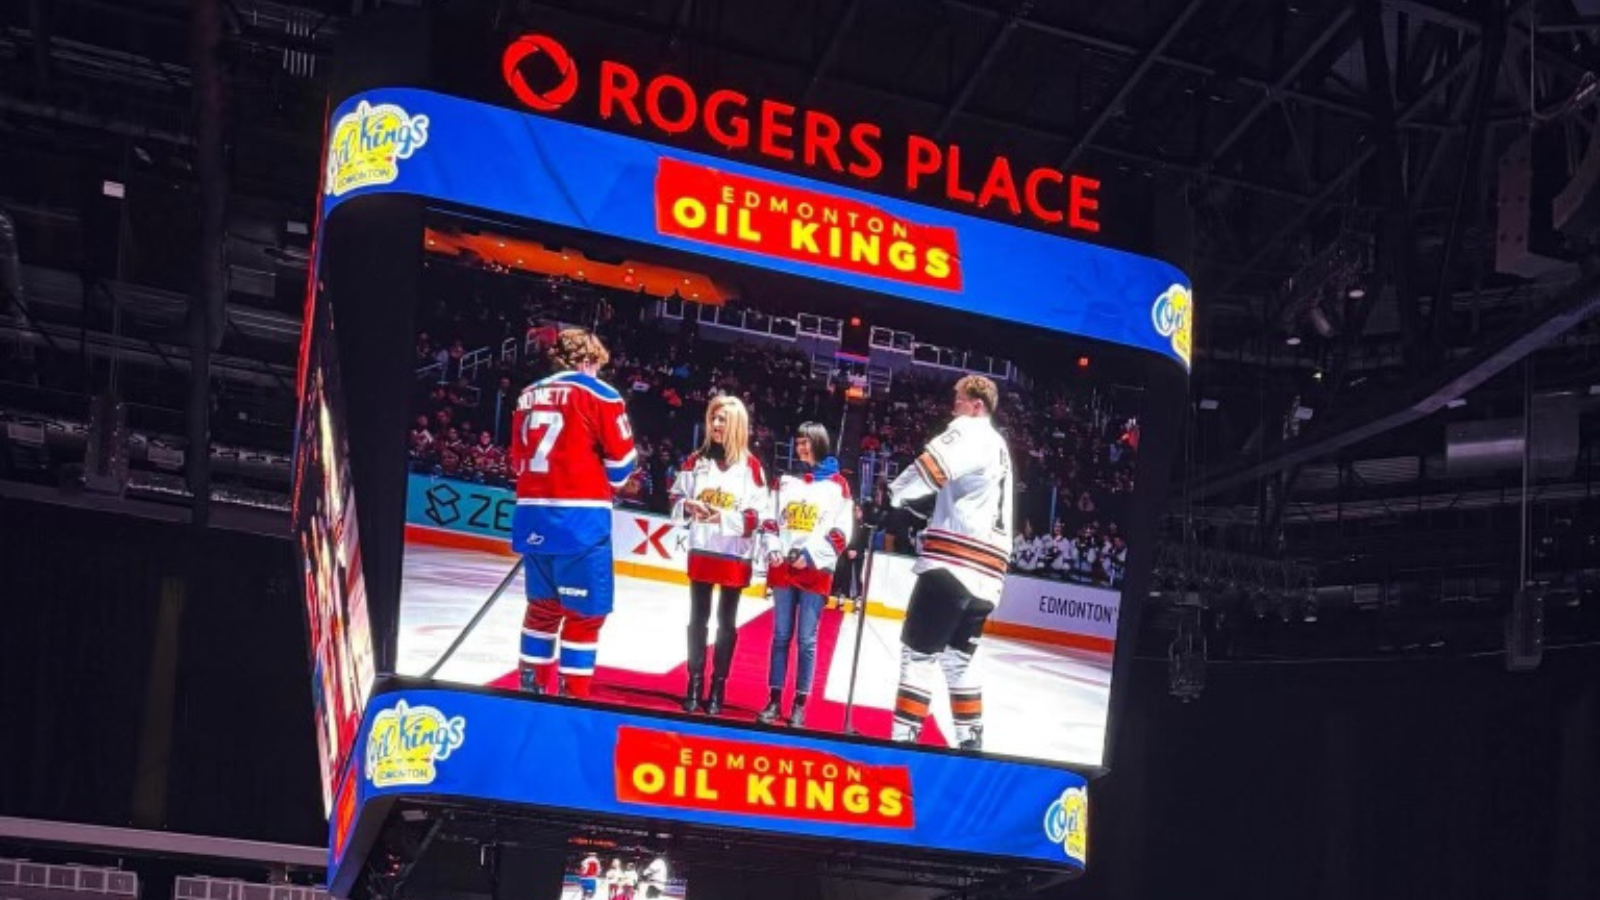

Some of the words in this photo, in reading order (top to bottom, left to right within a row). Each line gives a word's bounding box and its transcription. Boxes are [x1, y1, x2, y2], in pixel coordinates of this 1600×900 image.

[600, 60, 882, 179] ROGERS
[907, 136, 1101, 232] PLACE
[672, 197, 761, 242] OIL
[790, 219, 951, 278] KINGS
[722, 186, 907, 238] EDMONTON
[632, 763, 718, 800] OIL
[747, 773, 903, 817] KINGS
[680, 748, 861, 782] EDMONTON
